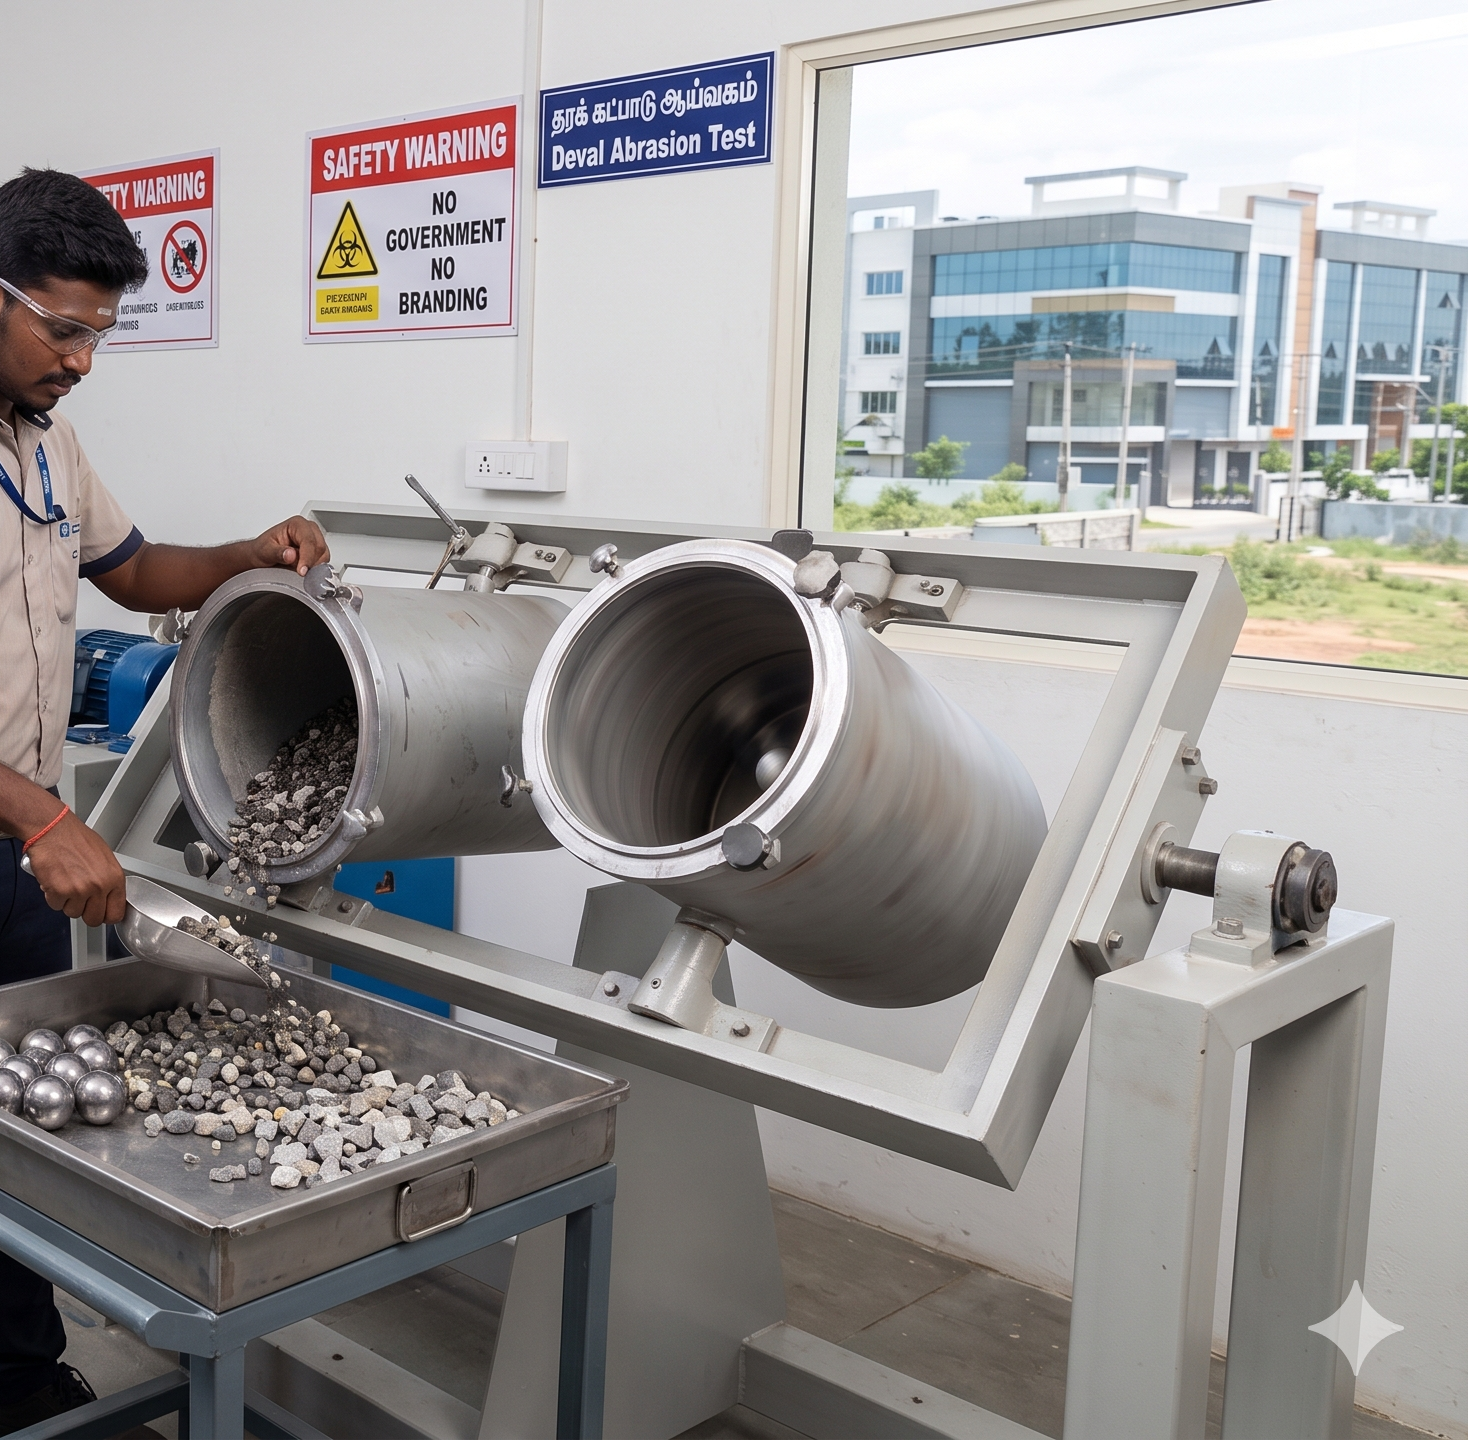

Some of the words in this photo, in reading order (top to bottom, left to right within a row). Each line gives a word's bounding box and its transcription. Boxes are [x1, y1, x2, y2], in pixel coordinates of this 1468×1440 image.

[550, 97, 589, 138] தரக்
[660, 70, 758, 117] ஆய்வகம்
[322, 139, 400, 182] SAFETY
[404, 122, 508, 170] WARNING
[551, 139, 604, 172] Deval
[609, 129, 701, 164] Abrasion
[708, 120, 756, 152] Test
[132, 170, 206, 208] WARNING
[432, 190, 457, 216] NO
[385, 217, 507, 253] GOVERNMENT
[431, 256, 456, 281] NO
[398, 286, 488, 315] BRANDING
